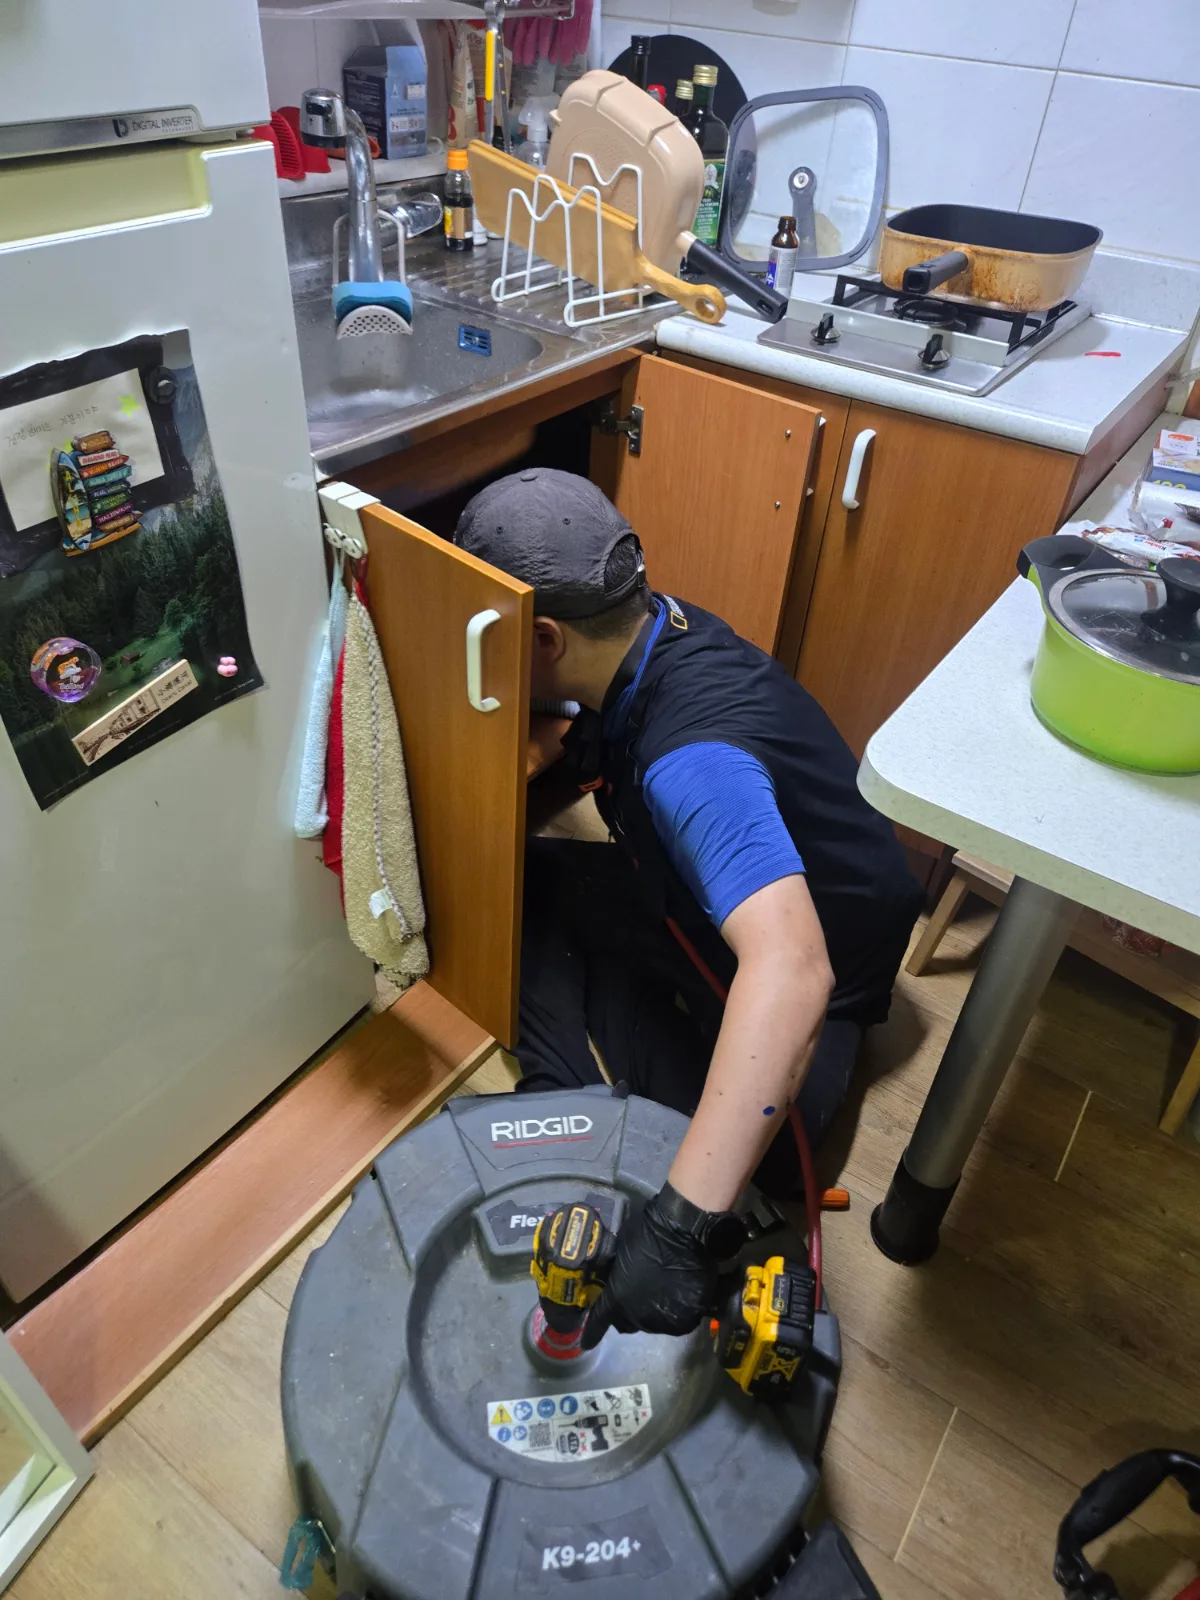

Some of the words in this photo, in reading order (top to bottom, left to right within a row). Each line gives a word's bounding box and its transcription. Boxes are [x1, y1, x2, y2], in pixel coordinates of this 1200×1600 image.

[131, 119, 161, 131] DIGITAL
[161, 115, 193, 127] INVERTER
[491, 1115, 593, 1142] RIDGID
